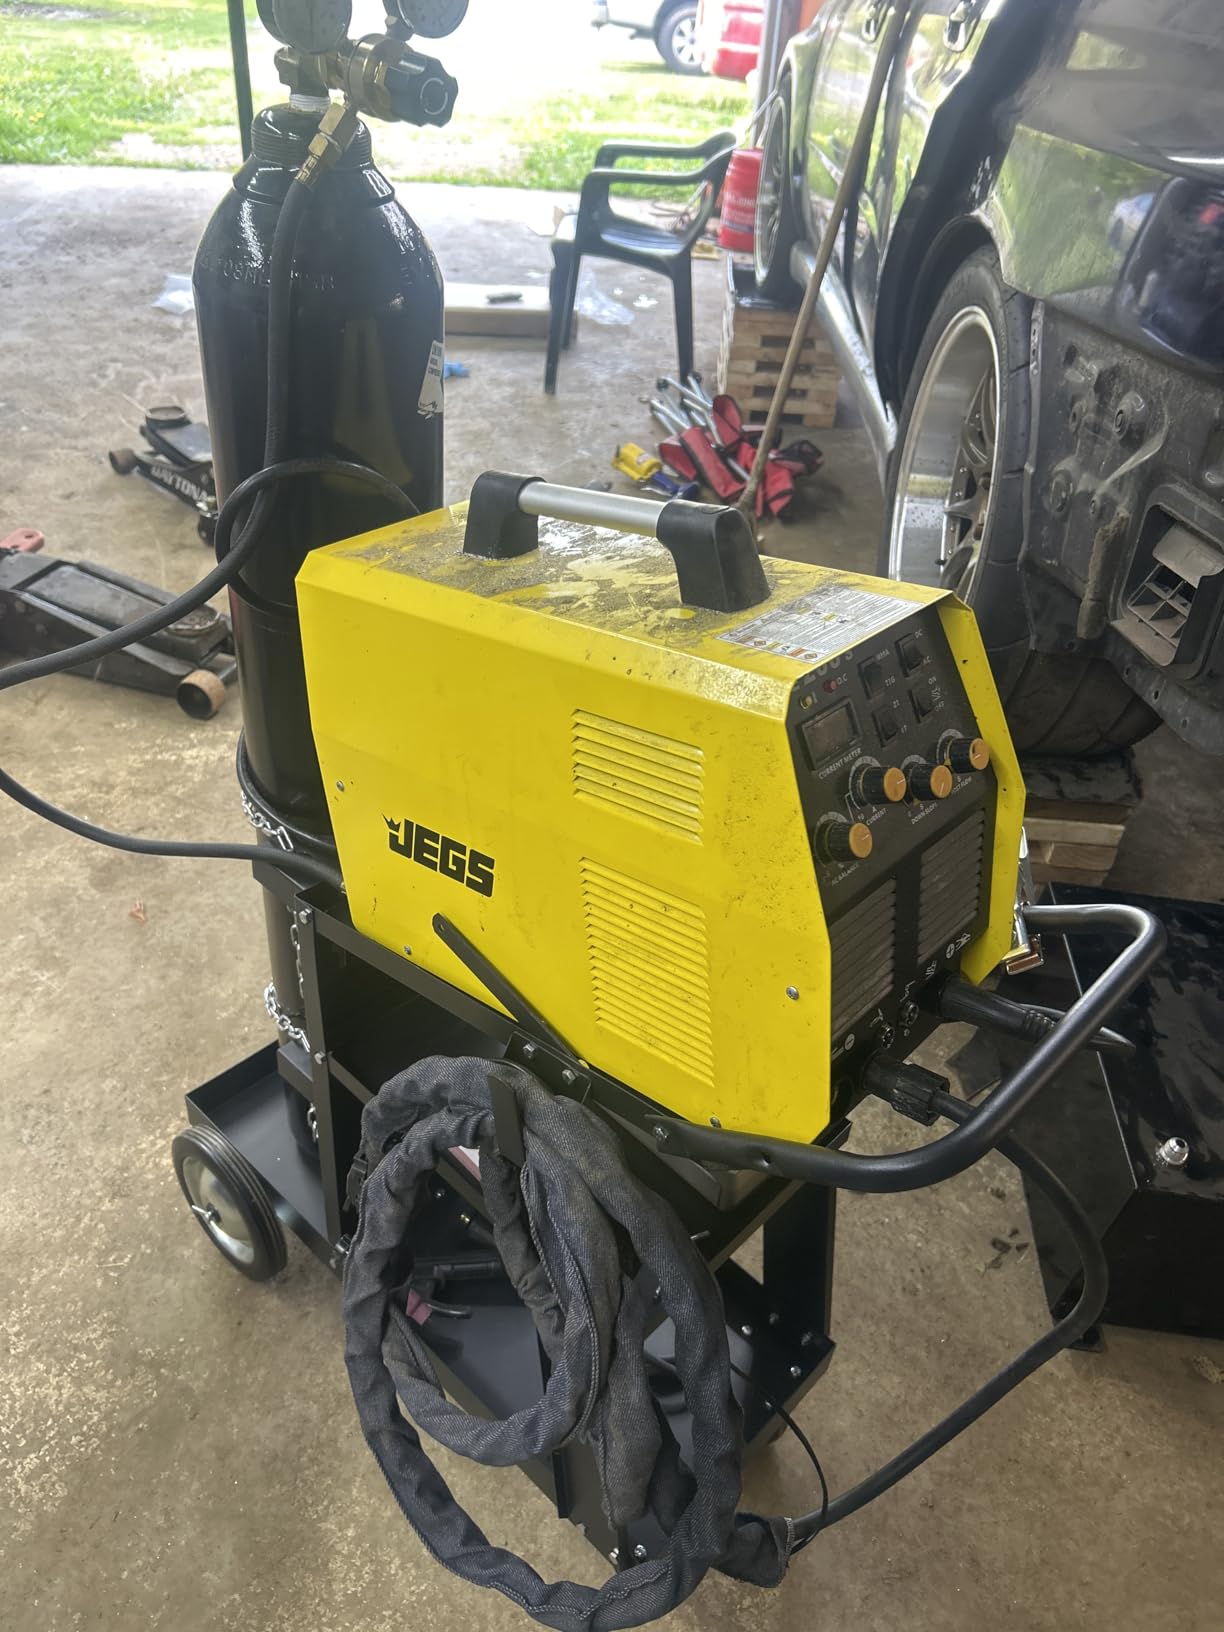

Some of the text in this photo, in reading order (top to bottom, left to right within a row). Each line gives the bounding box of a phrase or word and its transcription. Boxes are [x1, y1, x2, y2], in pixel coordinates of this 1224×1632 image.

[818, 747, 862, 780] CURRENT METER
[866, 807, 887, 826] CURRENT
[388, 818, 495, 898] JEGS
